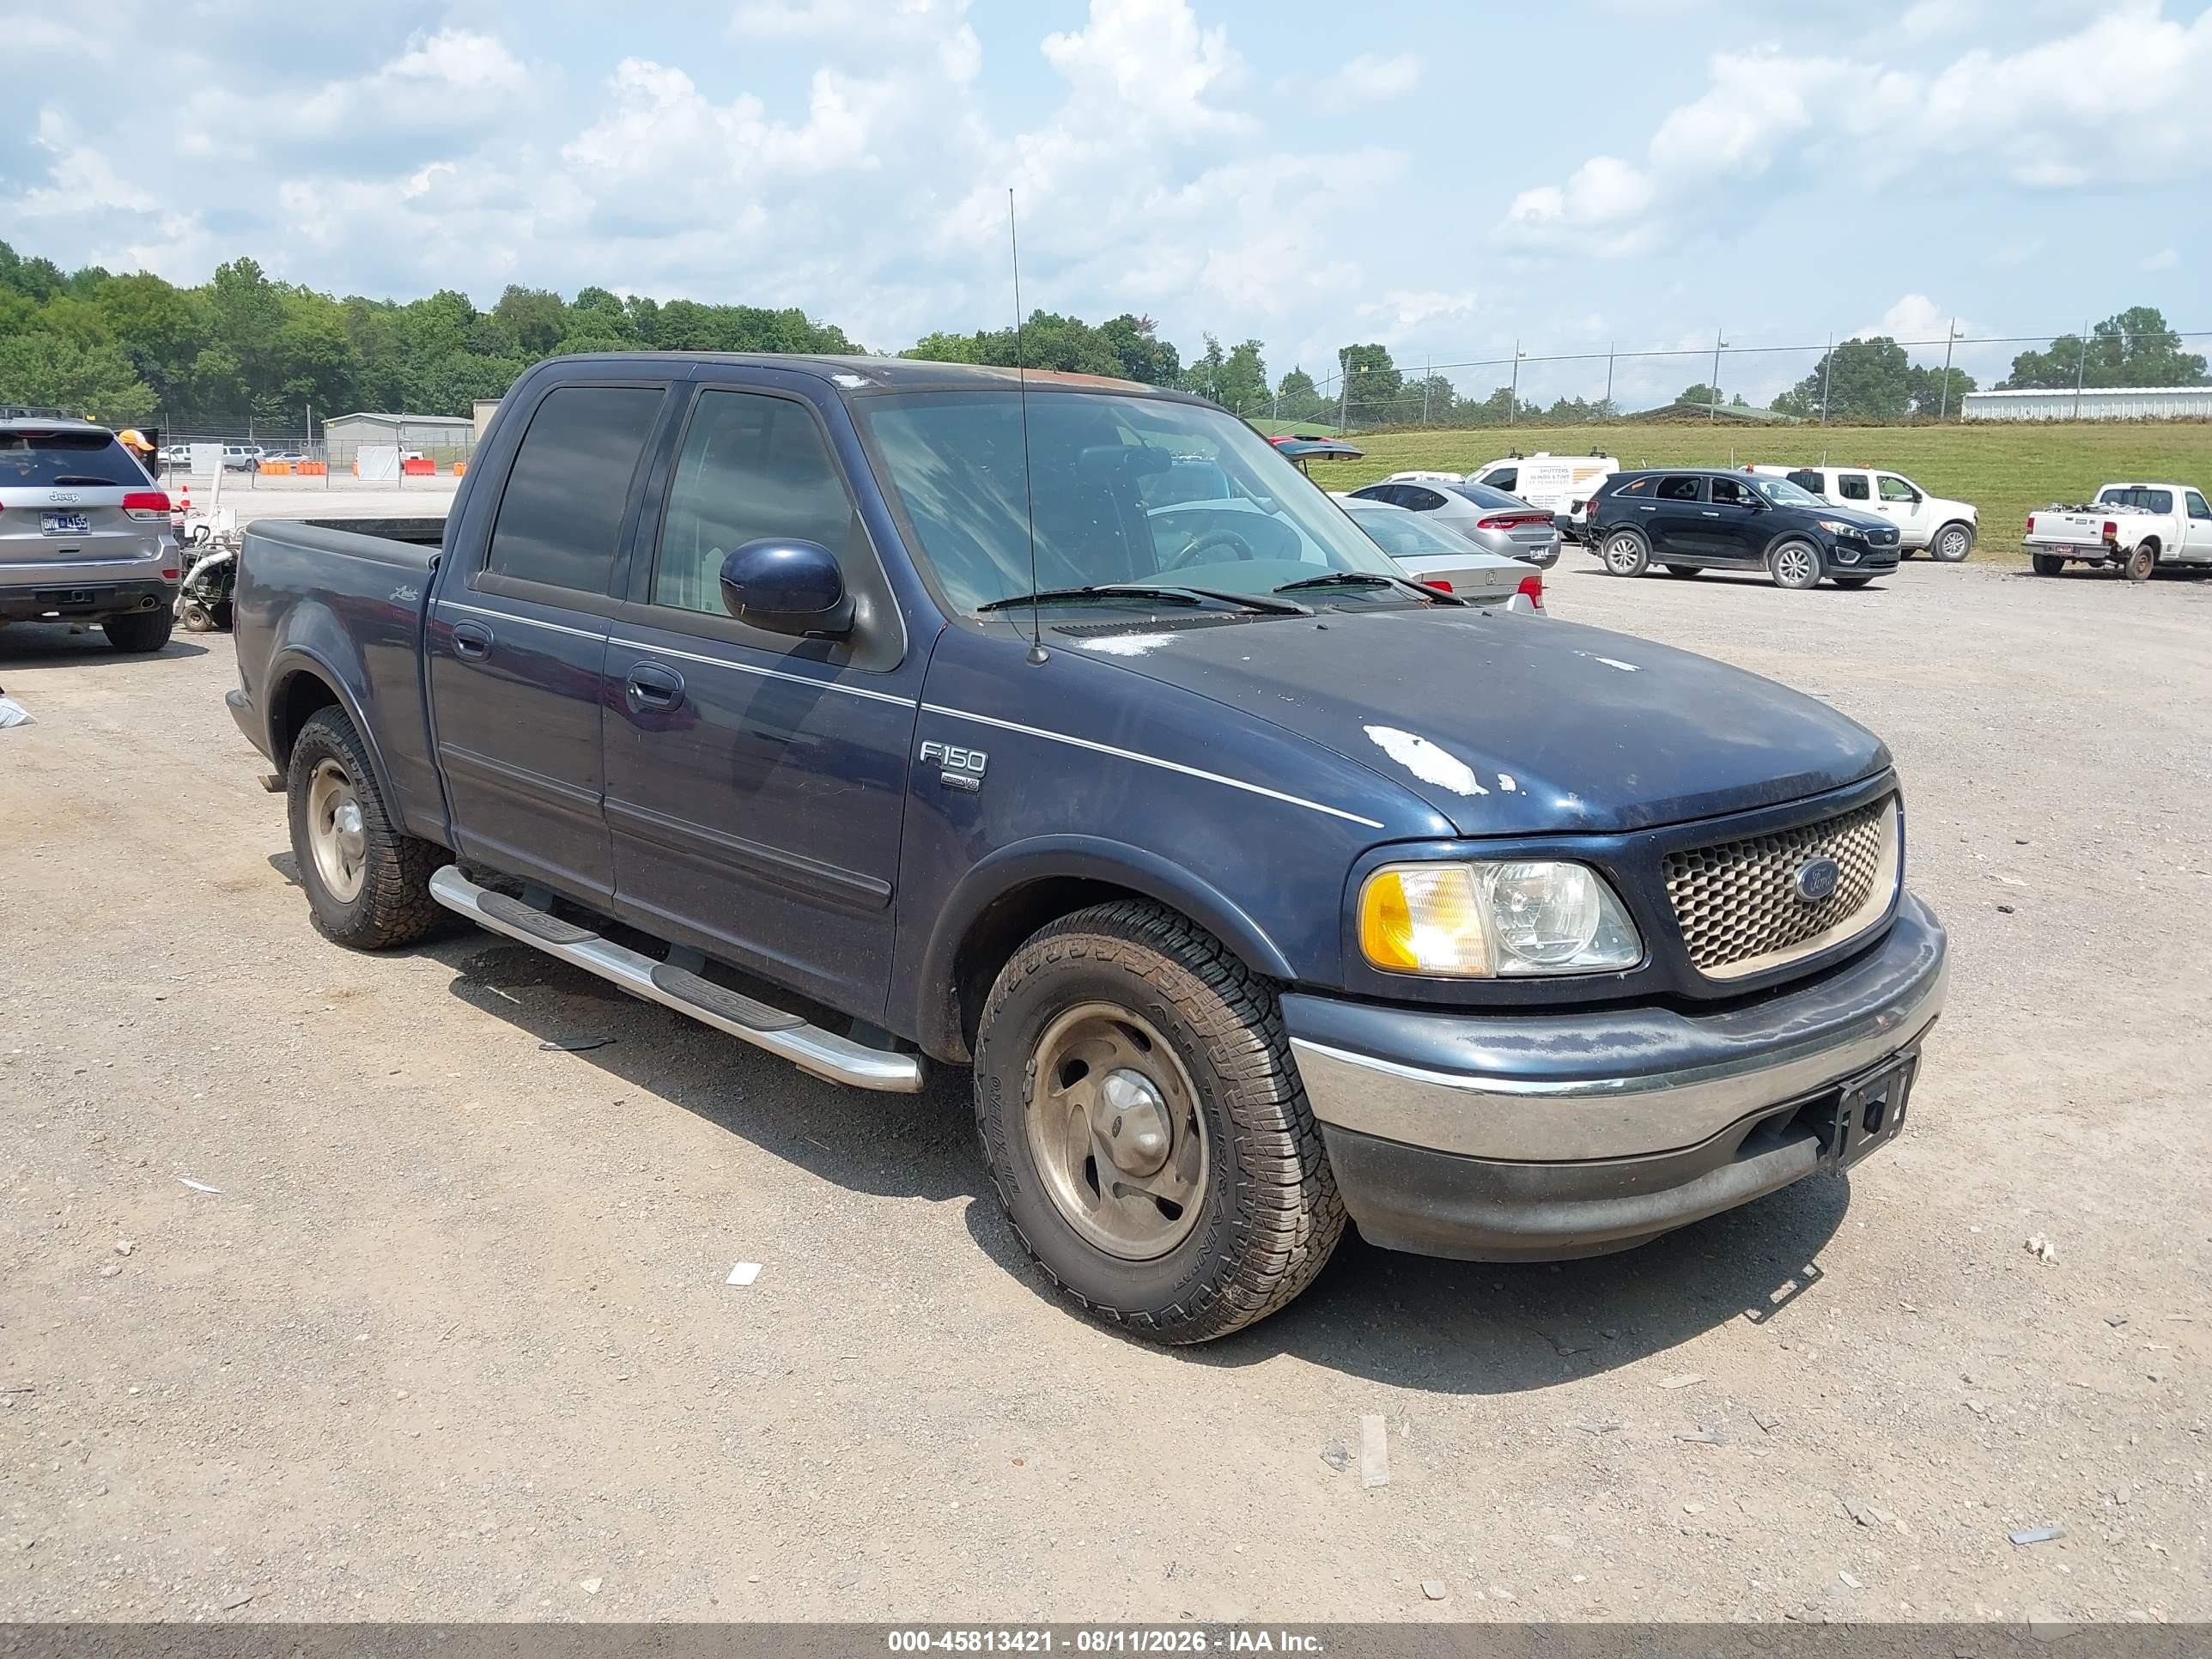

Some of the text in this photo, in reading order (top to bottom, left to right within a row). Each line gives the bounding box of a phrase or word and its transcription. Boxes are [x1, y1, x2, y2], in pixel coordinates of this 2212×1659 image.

[49, 491, 80, 501] Jeep
[67, 517, 87, 528] 4155
[1810, 866, 1833, 892] Ford
[1147, 1003, 1196, 1065] ALL
